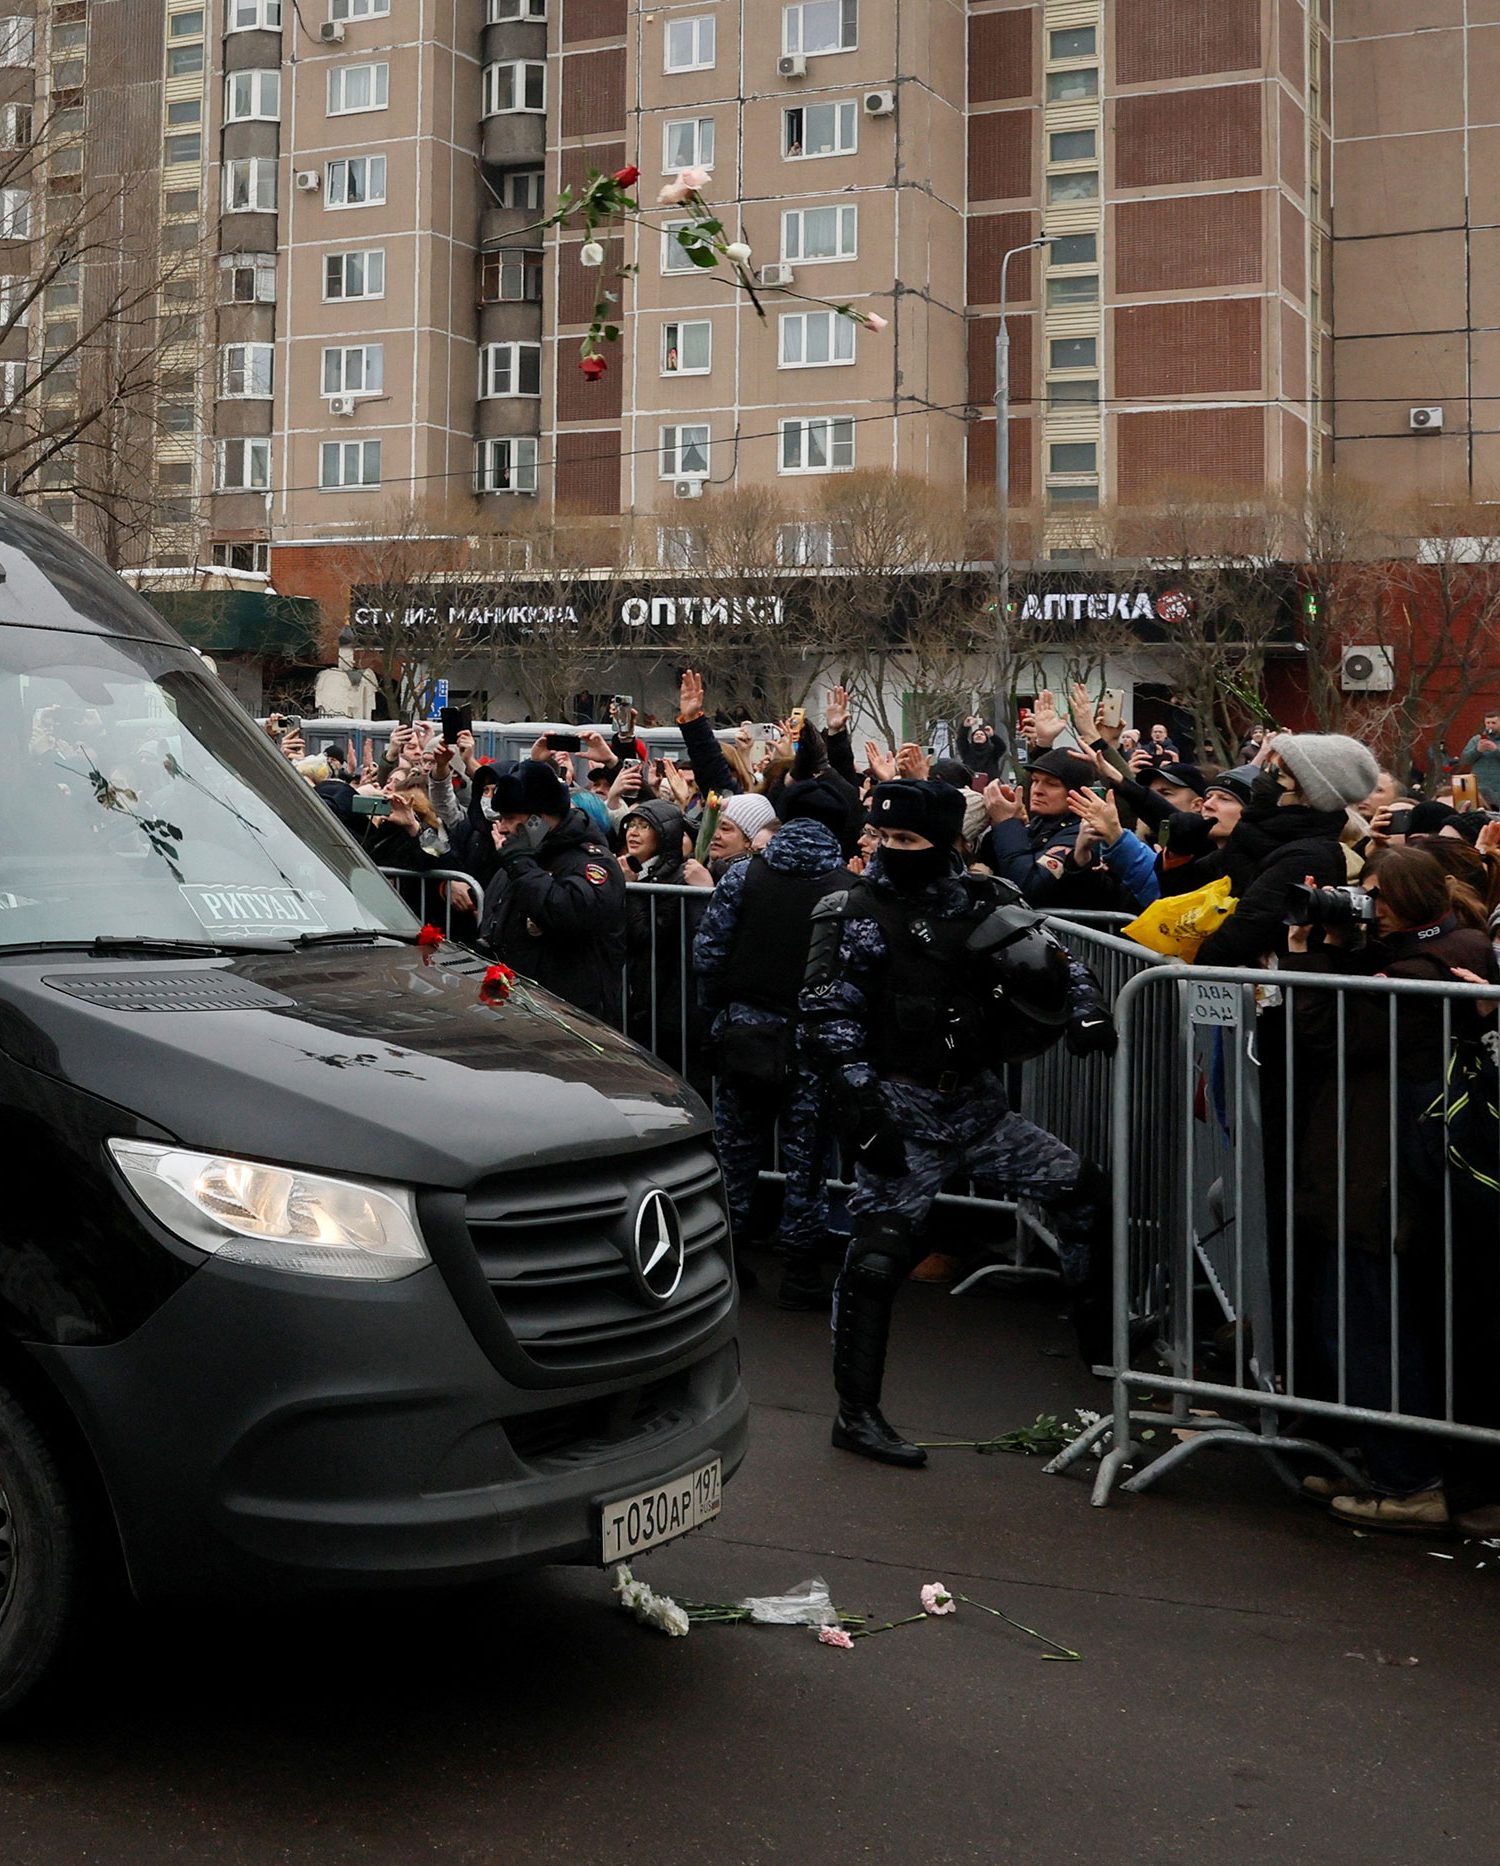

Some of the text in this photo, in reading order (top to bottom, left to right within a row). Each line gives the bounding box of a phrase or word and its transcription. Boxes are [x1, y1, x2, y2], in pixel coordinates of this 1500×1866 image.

[1021, 593, 1155, 620] АПТЕКА
[199, 891, 311, 921] РИТУАЛ
[1417, 926, 1441, 940] EOS
[695, 1464, 719, 1504] 197
